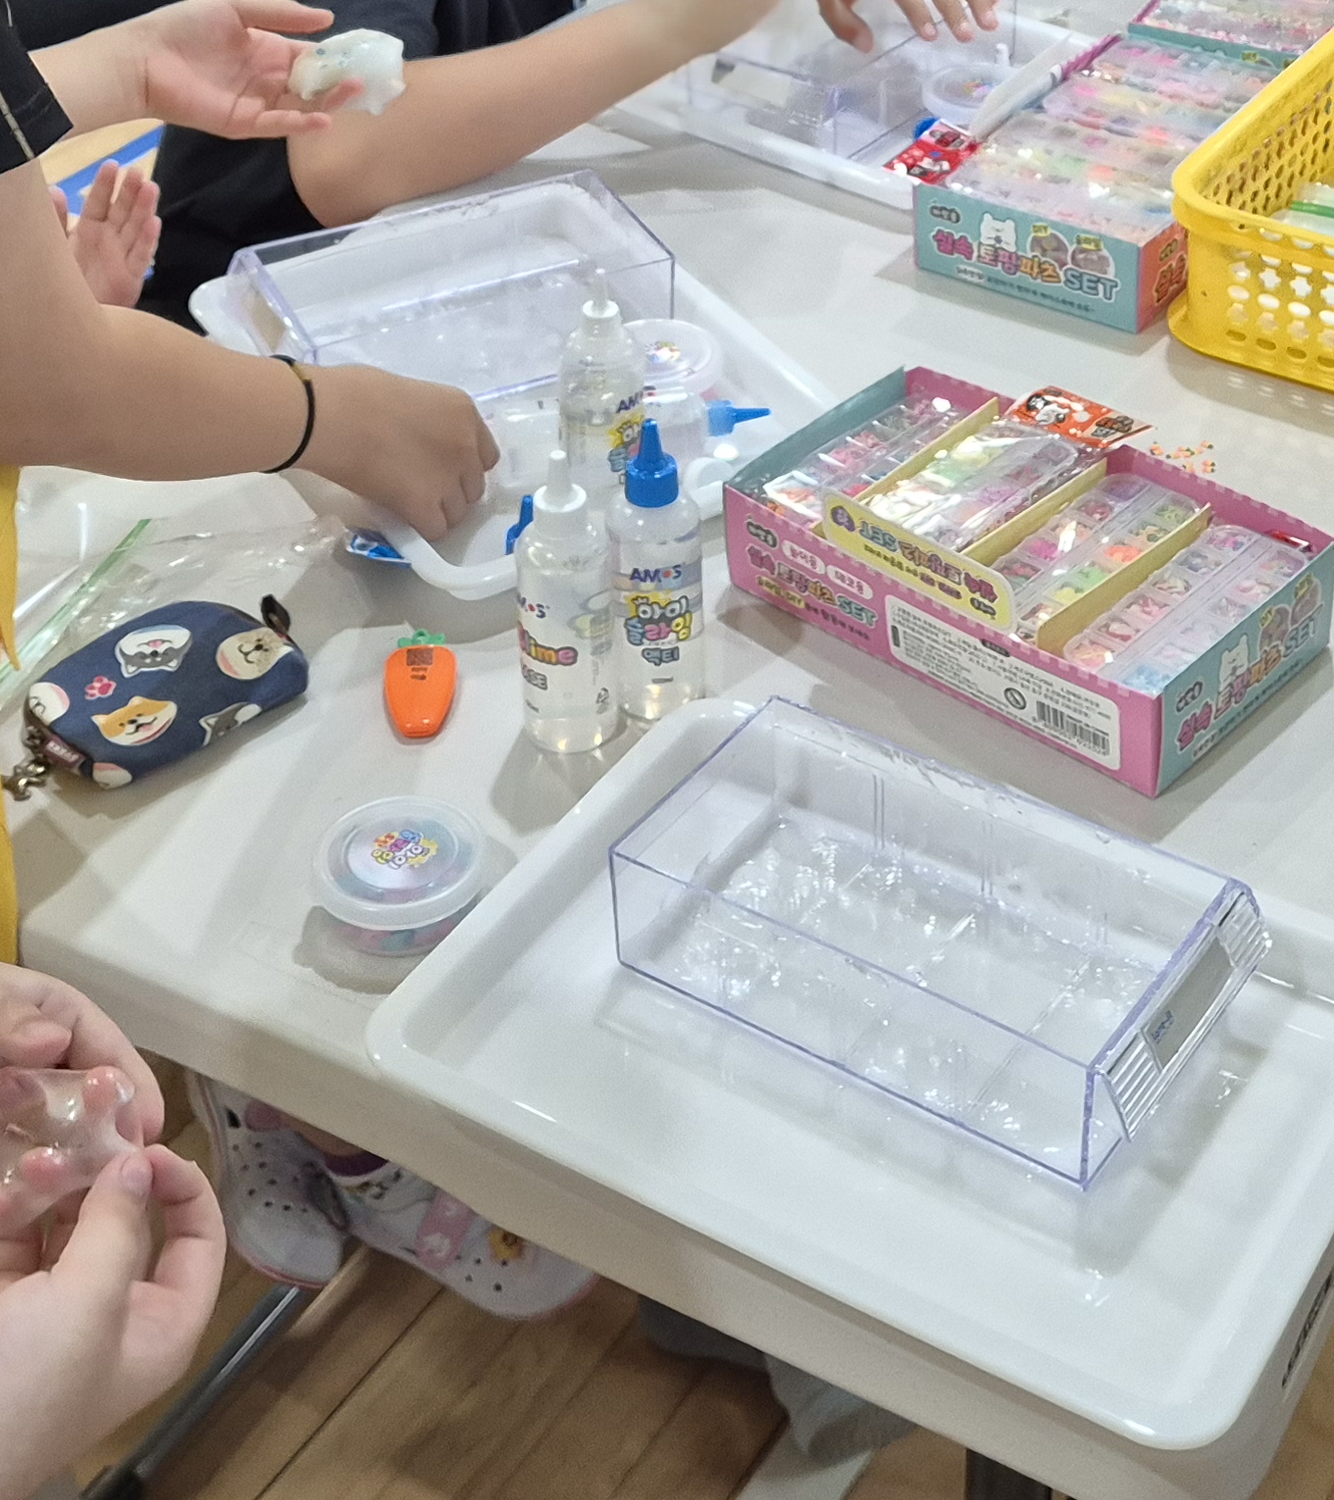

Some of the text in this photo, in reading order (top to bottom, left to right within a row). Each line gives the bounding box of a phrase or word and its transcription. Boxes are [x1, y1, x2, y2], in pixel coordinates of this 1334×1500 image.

[932, 228, 974, 261] 실속
[977, 242, 1063, 284] 토핑파츠
[1063, 267, 1119, 301] SET
[630, 564, 682, 583] AMOS
[636, 595, 689, 621] 아이
[836, 594, 878, 628] SET
[624, 611, 693, 646] 슬라임
[1282, 603, 1324, 659] SET
